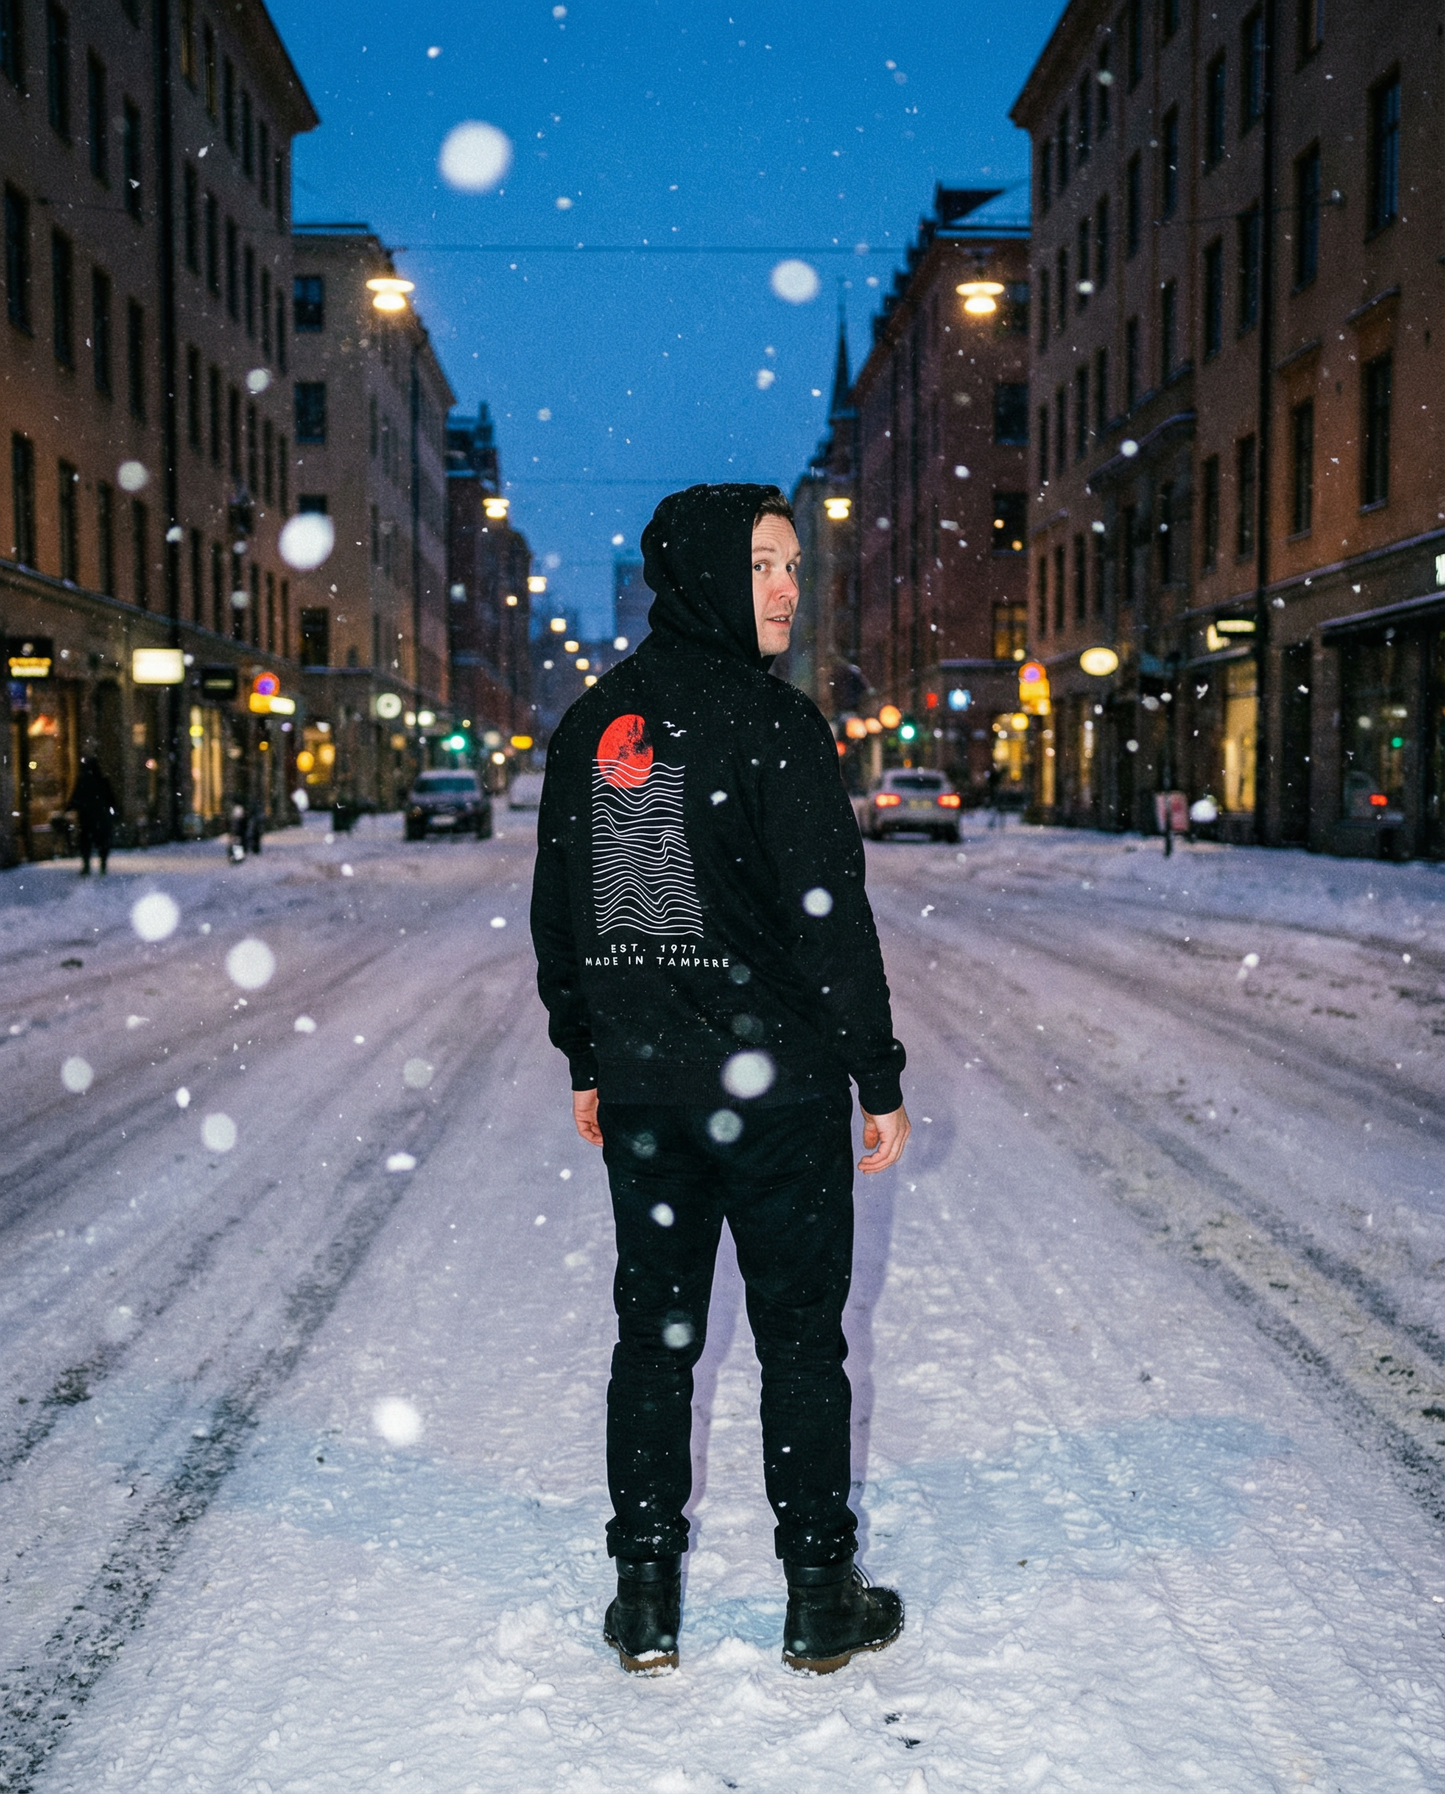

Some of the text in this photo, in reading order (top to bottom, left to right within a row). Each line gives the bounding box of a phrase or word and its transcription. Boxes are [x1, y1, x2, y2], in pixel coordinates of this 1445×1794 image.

[611, 943, 696, 955] EST. 1977
[585, 955, 730, 968] MADE IN TAMPERE
